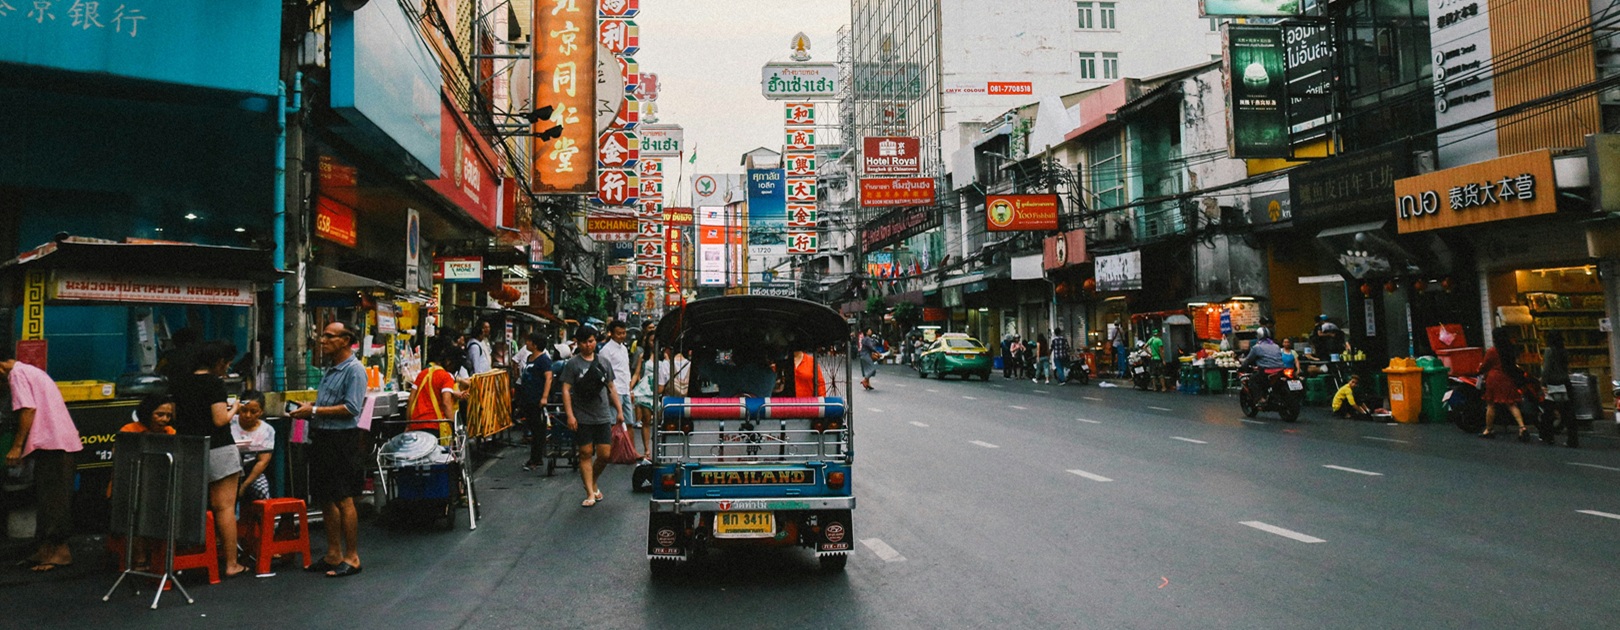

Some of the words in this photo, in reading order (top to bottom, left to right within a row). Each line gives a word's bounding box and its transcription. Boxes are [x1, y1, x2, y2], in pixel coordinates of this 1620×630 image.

[768, 72, 834, 93] ฮั่วเซ่งเฮง
[641, 136, 678, 151] ซ่งเฮง
[866, 157, 889, 165] Hotel
[892, 157, 917, 166] Royal
[793, 106, 809, 250] 和成興大金行
[1448, 173, 1534, 210] 泰货大本营
[317, 213, 331, 233] GSB
[588, 220, 637, 230] EXCHANGE
[701, 470, 806, 485] THAILAND
[744, 514, 769, 525] 3411
